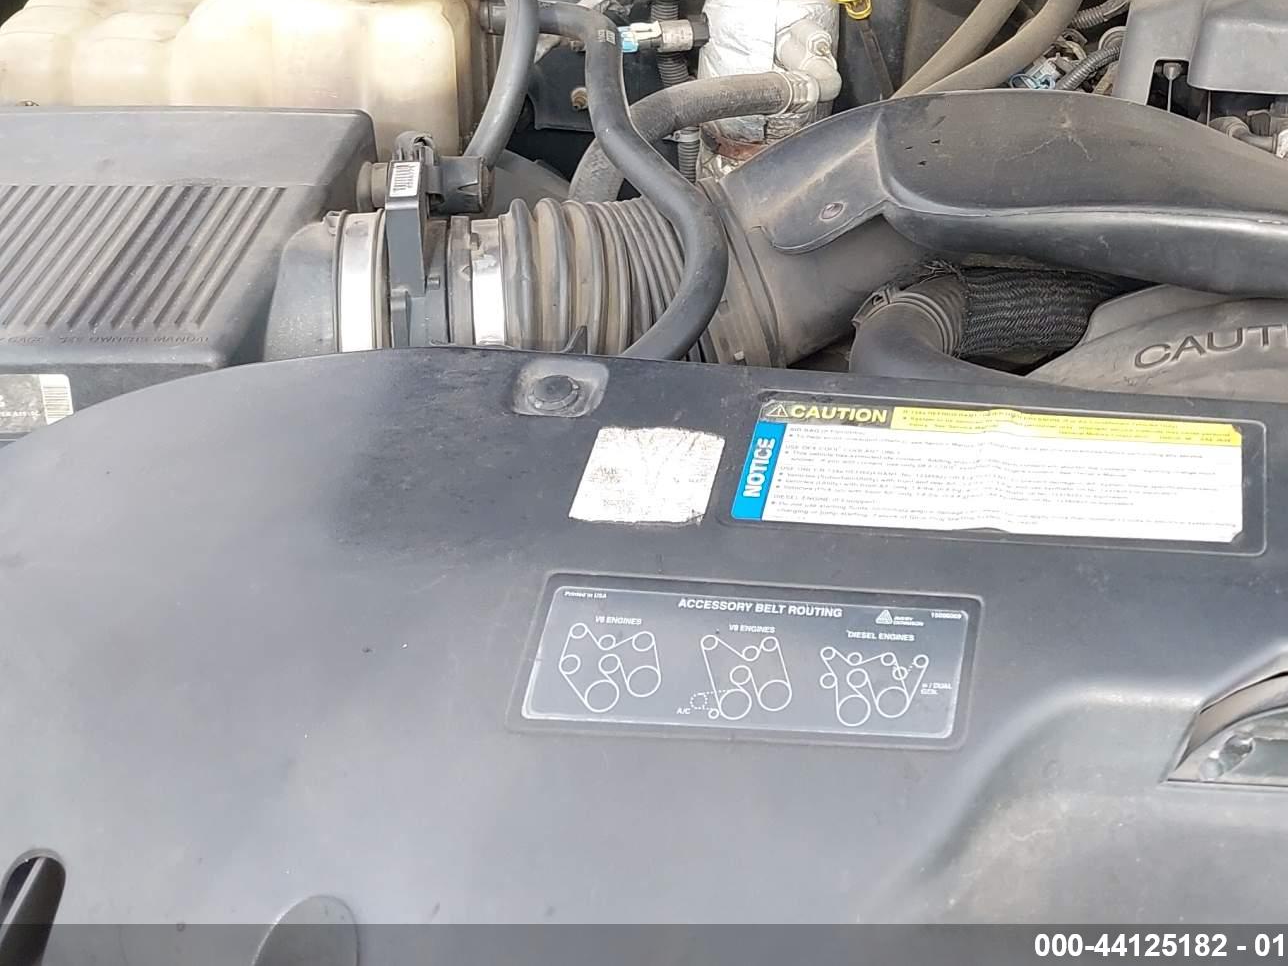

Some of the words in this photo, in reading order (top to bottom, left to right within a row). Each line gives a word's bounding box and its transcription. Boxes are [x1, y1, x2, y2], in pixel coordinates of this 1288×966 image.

[790, 404, 888, 423] CAUTION
[742, 437, 776, 498] NOTICE
[678, 598, 751, 614] ACCESSORY
[755, 603, 786, 614] BELT
[788, 605, 843, 617] ROUTING
[606, 616, 642, 626] ENGINES
[740, 625, 776, 634] ENGINES
[847, 631, 877, 640] DIESEL
[878, 632, 915, 642] ENGINES
